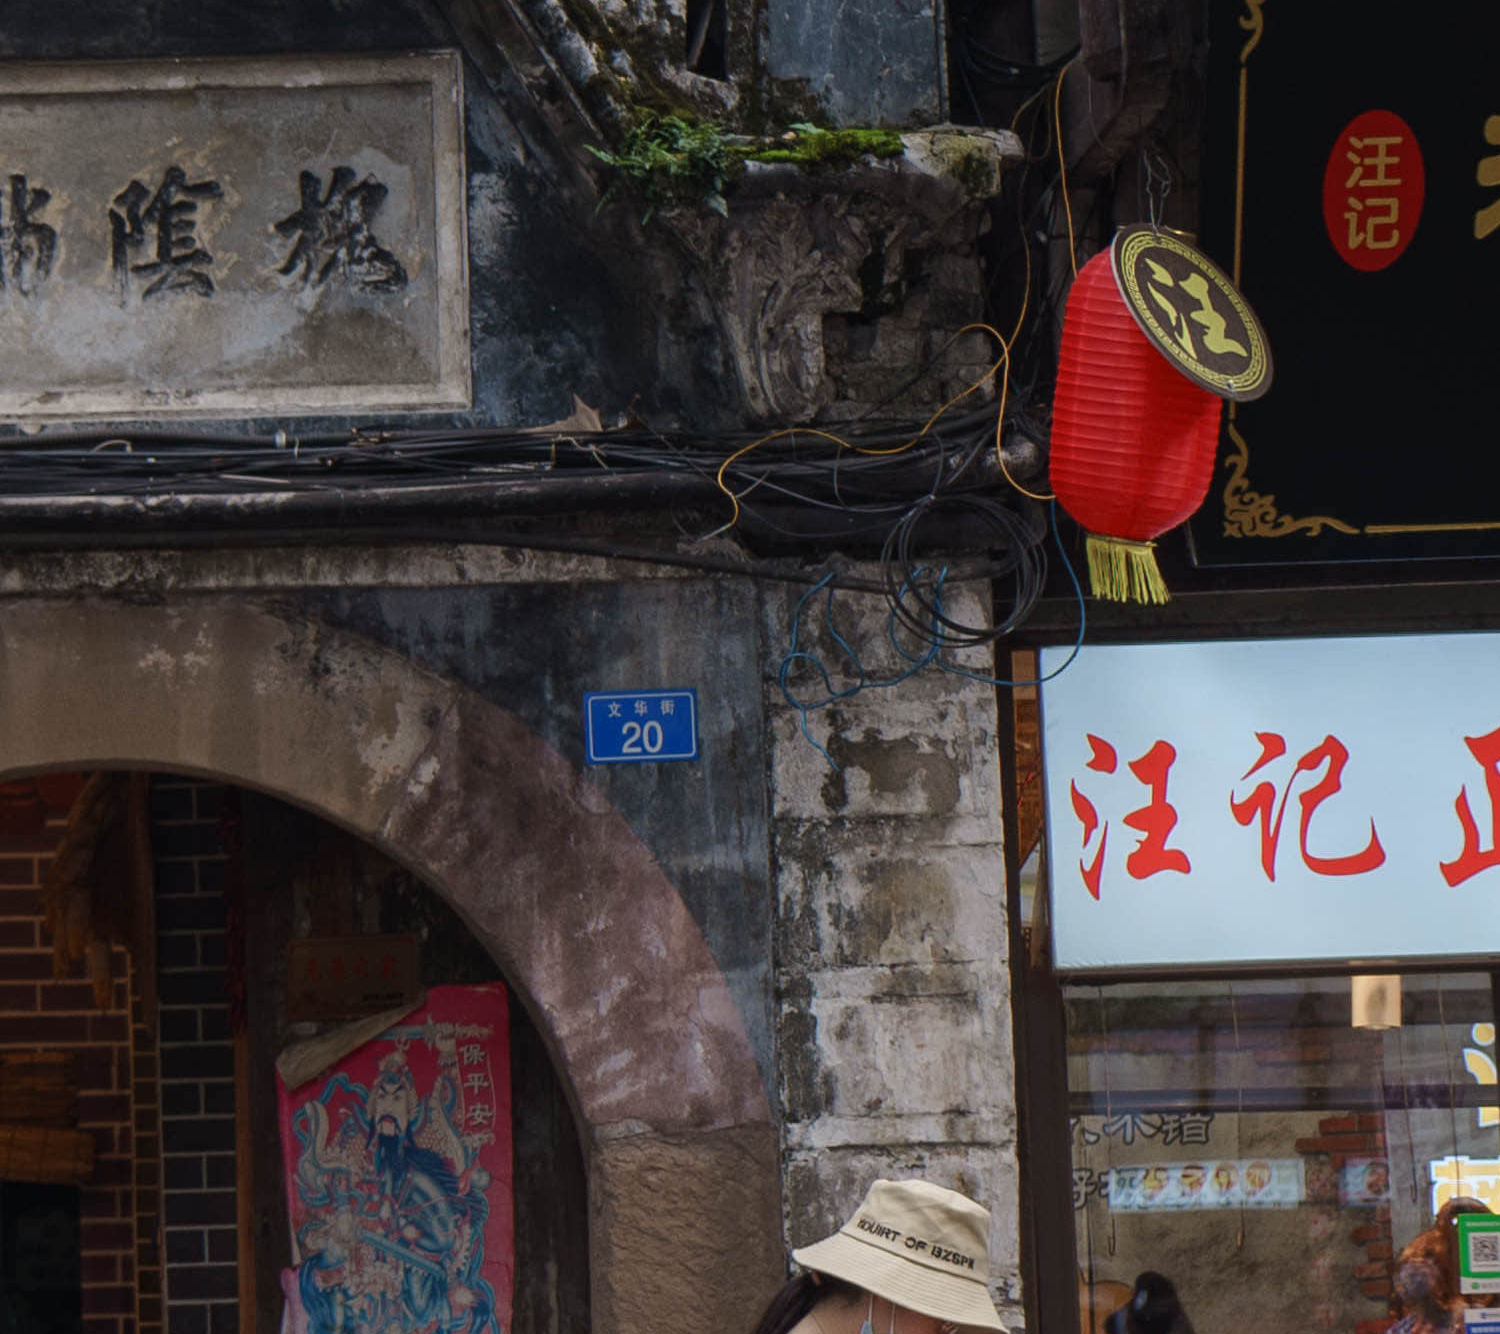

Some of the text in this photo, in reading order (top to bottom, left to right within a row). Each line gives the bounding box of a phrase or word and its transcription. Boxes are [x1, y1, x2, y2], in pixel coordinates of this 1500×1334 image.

[1343, 135, 1403, 250] 汪记
[1144, 257, 1248, 359] 汪
[607, 699, 675, 718] 文华街
[621, 720, 663, 754] 20
[459, 1043, 493, 1127] 保平安
